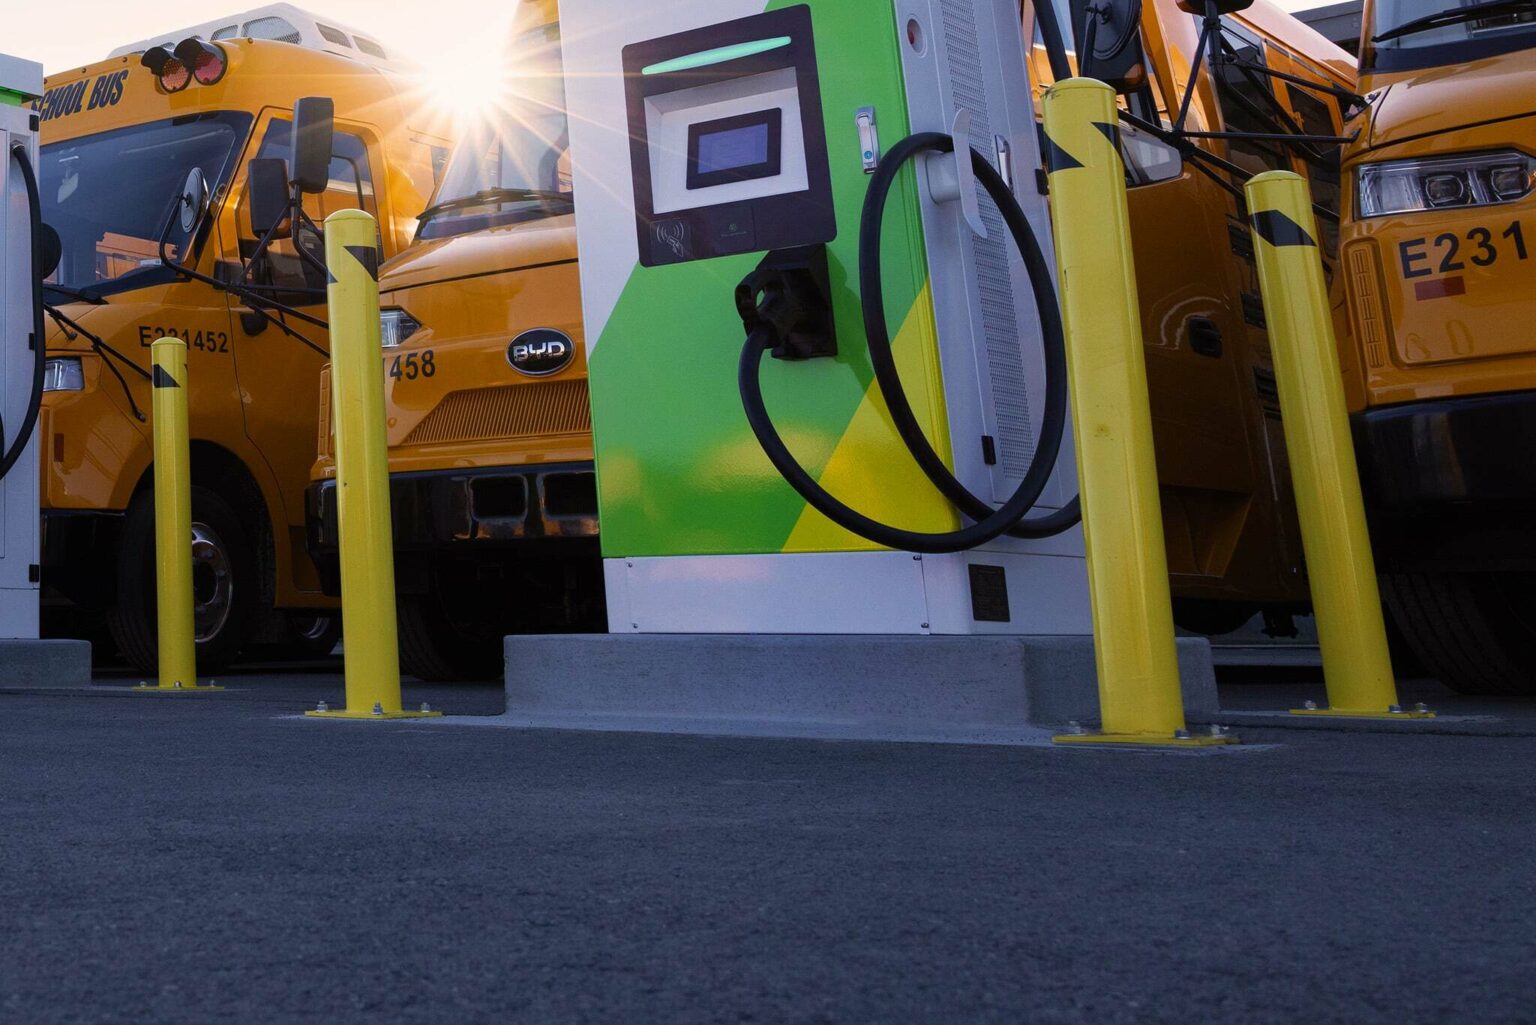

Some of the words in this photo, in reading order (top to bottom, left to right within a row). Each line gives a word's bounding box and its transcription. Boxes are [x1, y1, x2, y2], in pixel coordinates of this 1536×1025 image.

[86, 69, 129, 111] BUS
[1399, 220, 1528, 279] E231
[383, 350, 436, 382] 458
[513, 341, 566, 362] BYD
